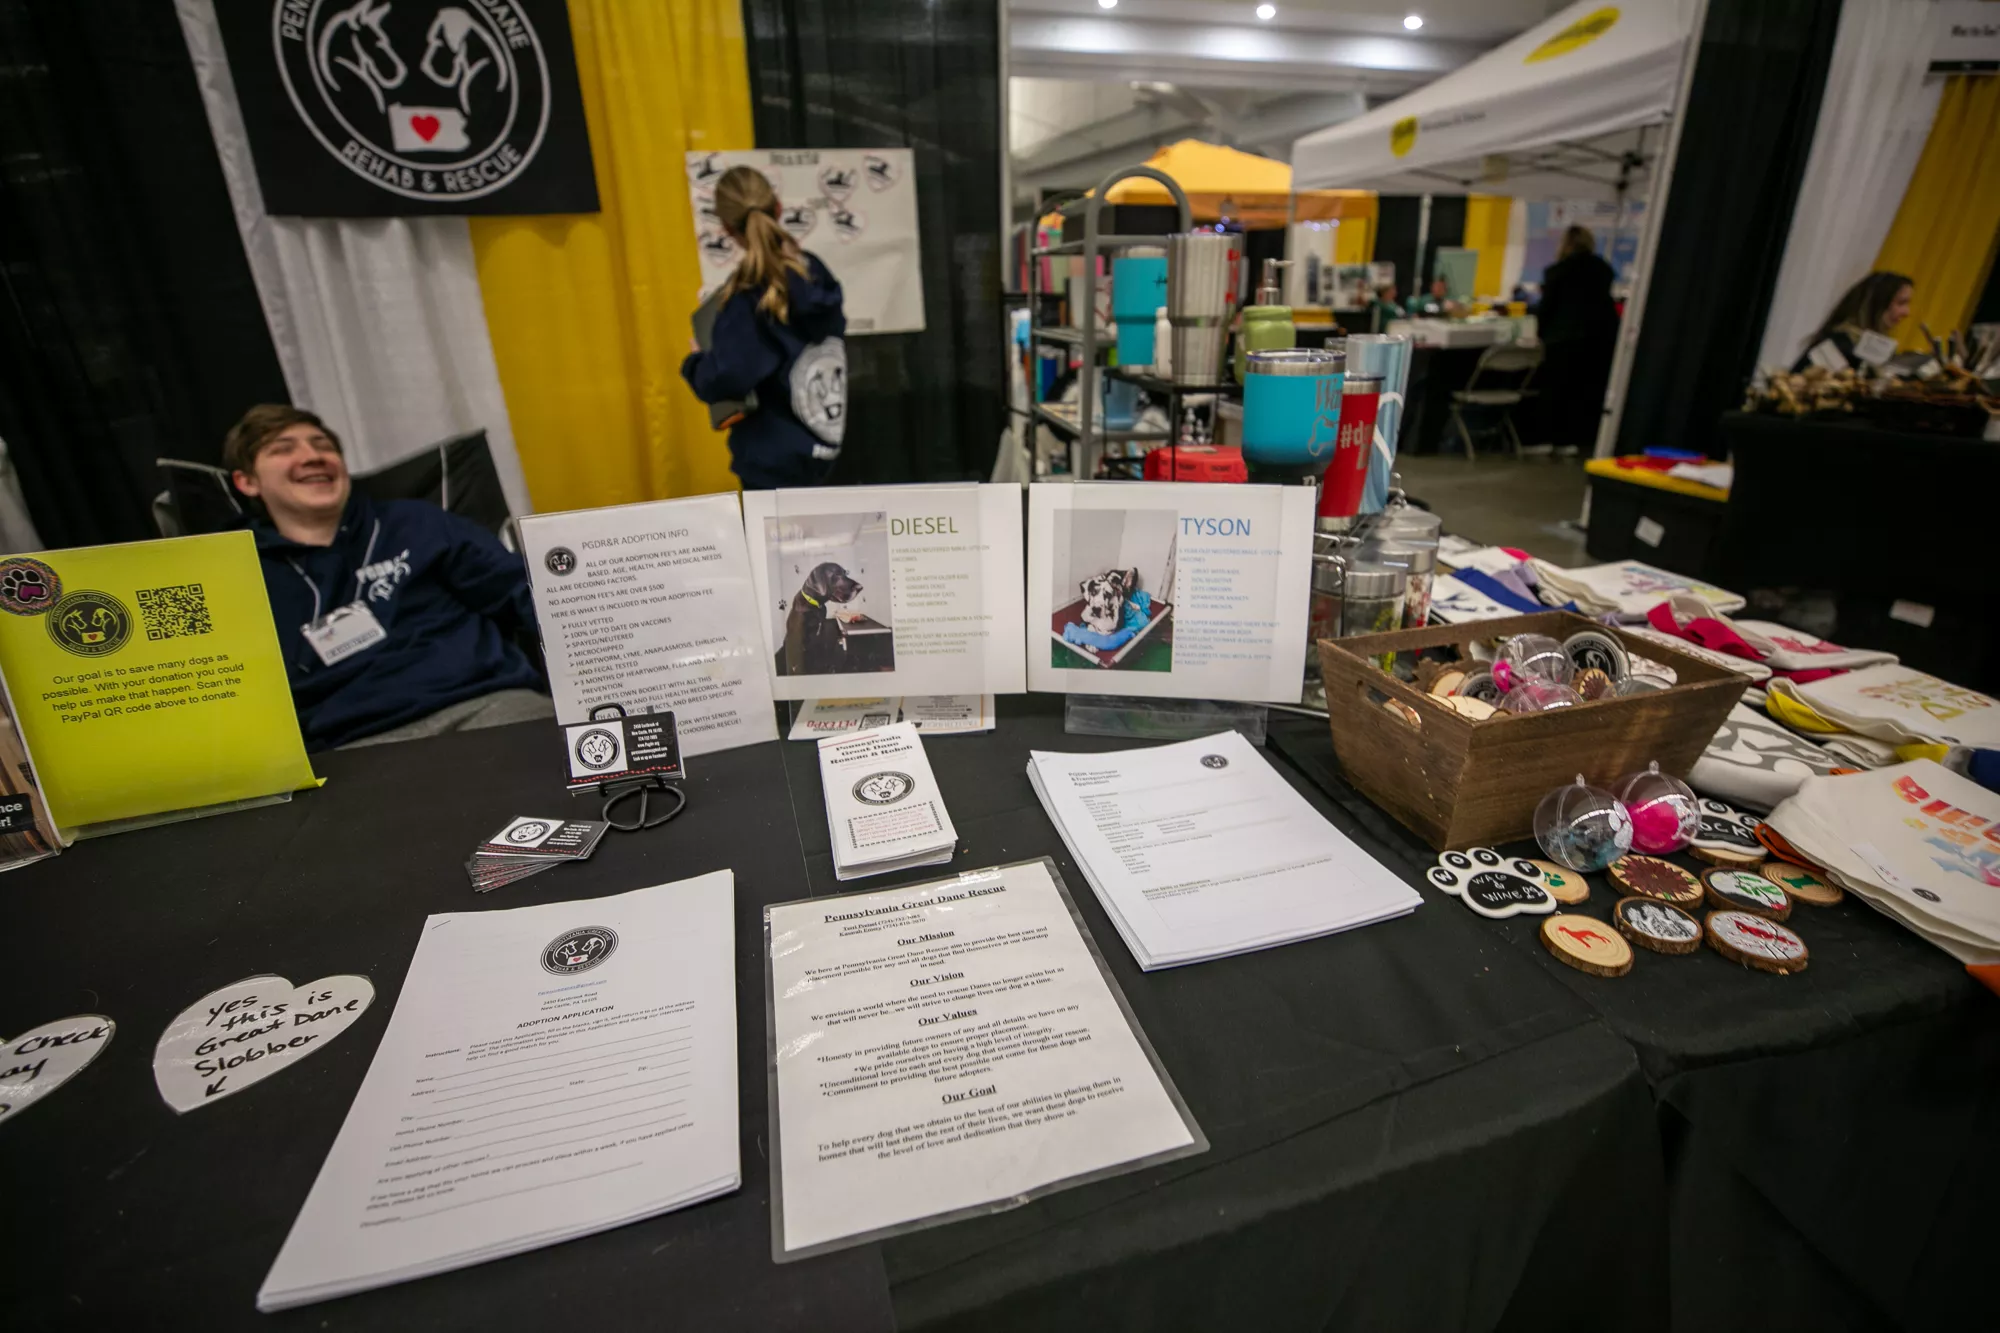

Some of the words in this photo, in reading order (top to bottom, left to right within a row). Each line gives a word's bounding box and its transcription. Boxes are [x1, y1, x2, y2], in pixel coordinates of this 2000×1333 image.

[342, 141, 415, 189] REHAB
[422, 172, 436, 191] &
[444, 143, 522, 192] RESCUE
[892, 516, 958, 536] DIESEL
[1180, 518, 1250, 536] TYSON
[582, 537, 619, 550] PGDR&R
[621, 531, 666, 545] ADOPTION
[668, 528, 689, 539] INFO
[585, 560, 596, 568] ALL
[608, 557, 623, 565] OUR
[625, 552, 658, 562] ADOPTION
[660, 550, 676, 558] FEE'S
[691, 544, 716, 553] ANIMAL
[656, 560, 671, 568] AND
[672, 556, 701, 566] MEDICAL
[700, 553, 722, 562] NEEDS
[559, 584, 572, 592] ARE
[573, 579, 605, 590] DECIDING
[560, 594, 596, 604] ADOPTION
[597, 591, 614, 599] FEE'S
[629, 586, 647, 594] OVER
[648, 584, 664, 592] $500
[551, 610, 568, 619] HERE
[577, 606, 597, 615] WHAT
[606, 600, 639, 610] INCLUDED
[648, 595, 666, 604] YOUR
[668, 590, 700, 601] ADOPTION
[702, 588, 713, 596] FEE
[568, 621, 587, 629] FULLY
[588, 617, 614, 626] VETTED
[570, 630, 588, 639] 100%
[589, 628, 599, 636] UP
[610, 624, 627, 632] DATE
[640, 617, 672, 628] VACCINES
[572, 632, 634, 648] SPAYED/NEUTERED
[574, 644, 624, 658] MICROCHIPPED
[52, 675, 75, 685] Our
[75, 670, 100, 684] goal
[104, 669, 113, 678] is
[115, 667, 127, 676] to
[128, 664, 154, 674] save
[157, 660, 186, 670] many
[188, 656, 213, 666] dogs
[216, 654, 229, 662] as
[578, 668, 592, 676] AND
[594, 664, 612, 674] FECAL
[615, 660, 638, 670] TESTED
[42, 685, 88, 700] possible.
[94, 680, 119, 691] With
[121, 678, 147, 690] your
[146, 672, 193, 685] donation
[196, 670, 215, 681] you
[217, 664, 244, 676] could
[52, 700, 76, 711] help
[79, 699, 93, 707] us
[96, 693, 126, 705] make
[128, 689, 149, 700] that
[151, 686, 193, 698] happen.
[197, 681, 223, 691] Scan
[225, 677, 241, 687] the
[61, 709, 100, 723] PayPal
[104, 705, 123, 717] QR
[123, 702, 151, 714] code
[154, 698, 186, 709] above
[188, 695, 200, 704] to
[200, 690, 239, 702] donate.
[824, 902, 898, 922] Pennsylvania
[901, 895, 934, 909] Great
[937, 892, 965, 903] Dane
[967, 886, 1006, 898] Rescue
[896, 936, 916, 946] Our
[918, 930, 955, 942] Mission
[910, 976, 929, 986] Our
[933, 971, 964, 982] Vision
[221, 1004, 288, 1031] this
[308, 991, 332, 1005] is
[517, 1015, 560, 1028] ADOPTION
[561, 1005, 614, 1020] APPLICATION
[918, 1015, 939, 1025] Our
[943, 1009, 978, 1021] Values
[195, 1020, 285, 1056] Great
[294, 1000, 358, 1026] Dane
[14, 1026, 110, 1054] Check
[194, 1035, 318, 1077] Slobber
[874, 1061, 893, 1072] pride
[895, 1053, 930, 1065] ourselves
[943, 1045, 968, 1055] having
[976, 1038, 993, 1048] high
[994, 1034, 1011, 1044] level
[1013, 1032, 1020, 1040] of
[934, 1074, 957, 1083] future
[958, 1067, 993, 1078] adopters.
[942, 1093, 964, 1103] Our
[968, 1085, 996, 1098] Goal
